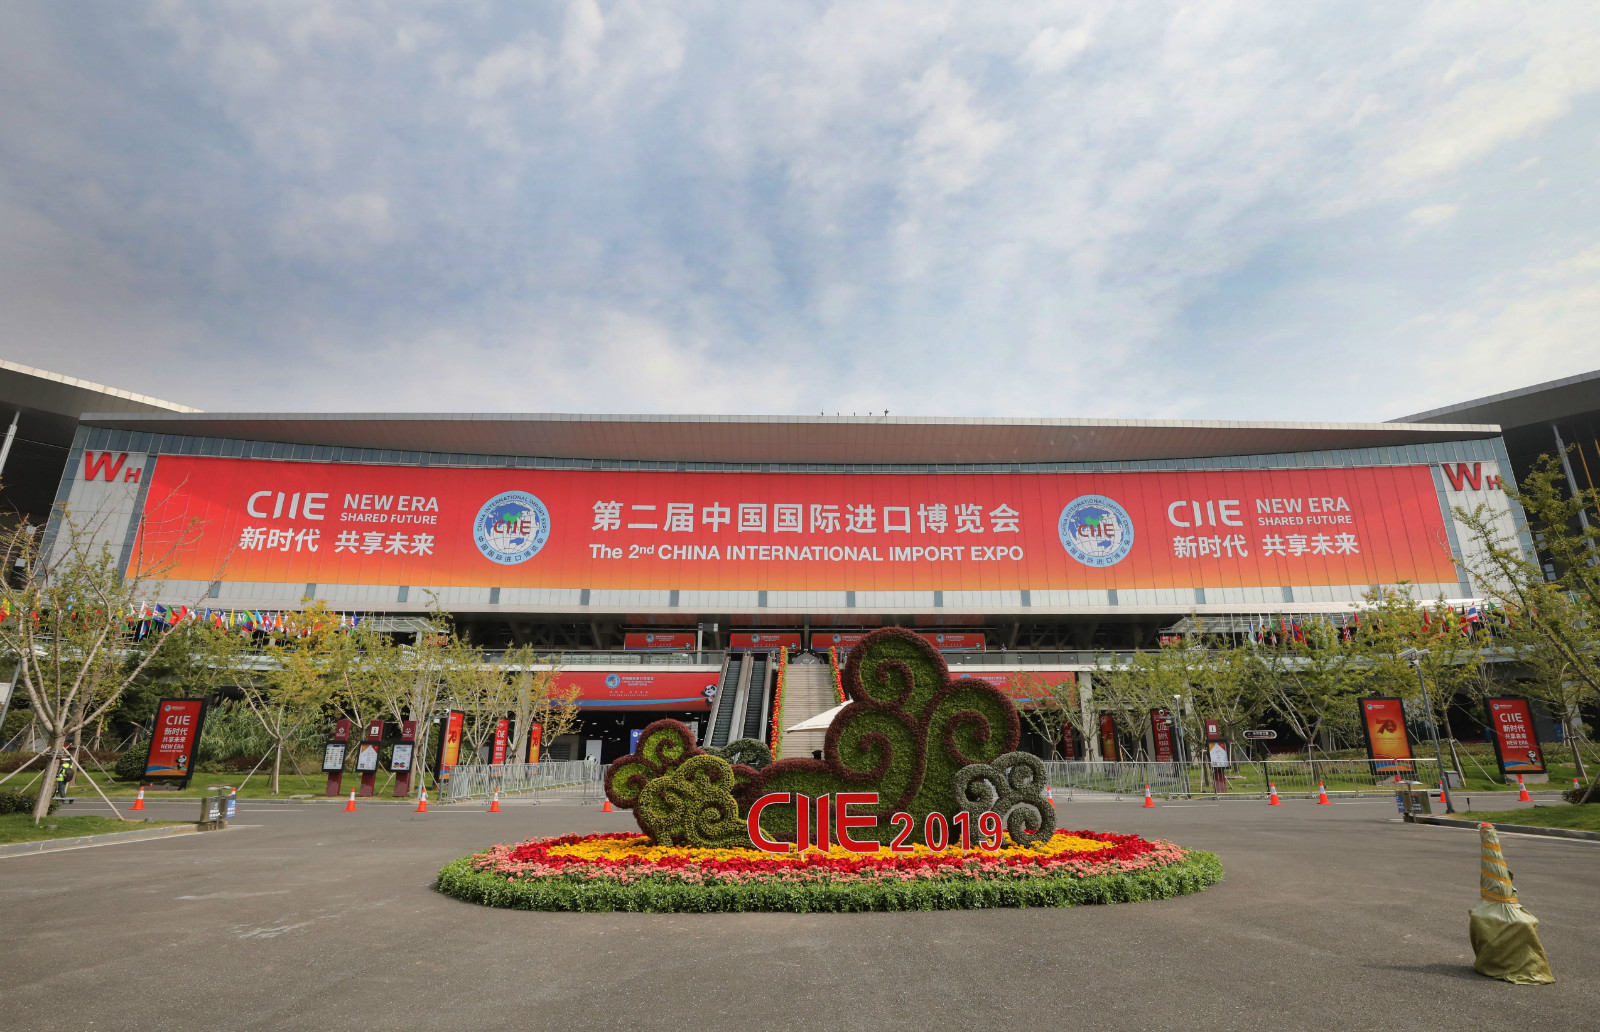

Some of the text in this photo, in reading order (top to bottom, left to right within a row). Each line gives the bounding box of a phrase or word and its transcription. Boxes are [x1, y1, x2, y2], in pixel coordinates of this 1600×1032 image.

[246, 490, 329, 520] CIIE
[343, 493, 439, 512] NEW ERA
[1256, 496, 1350, 514] NEW ERA
[340, 512, 438, 525] SHARED FUTURE
[477, 514, 486, 532] CHINA
[484, 494, 528, 514] INTERNATIONAL
[529, 499, 546, 517] IMPORT
[592, 500, 1020, 534] 第二届中国国际进口博览会
[1168, 499, 1244, 528] CIIE
[1258, 514, 1352, 526] SHARED FUTURE
[494, 520, 532, 534] CIIE
[1078, 524, 1115, 537] CIIE
[239, 526, 434, 556] 新时代 共享未来
[1173, 532, 1360, 558] 新时代 共享未来
[589, 544, 1024, 562] The 2nd CHINA INTERNATIONAL IMPORT EXPO
[166, 716, 191, 725] CIIE
[1500, 713, 1523, 722] CIIE
[747, 792, 1002, 854] CIIE 2019
